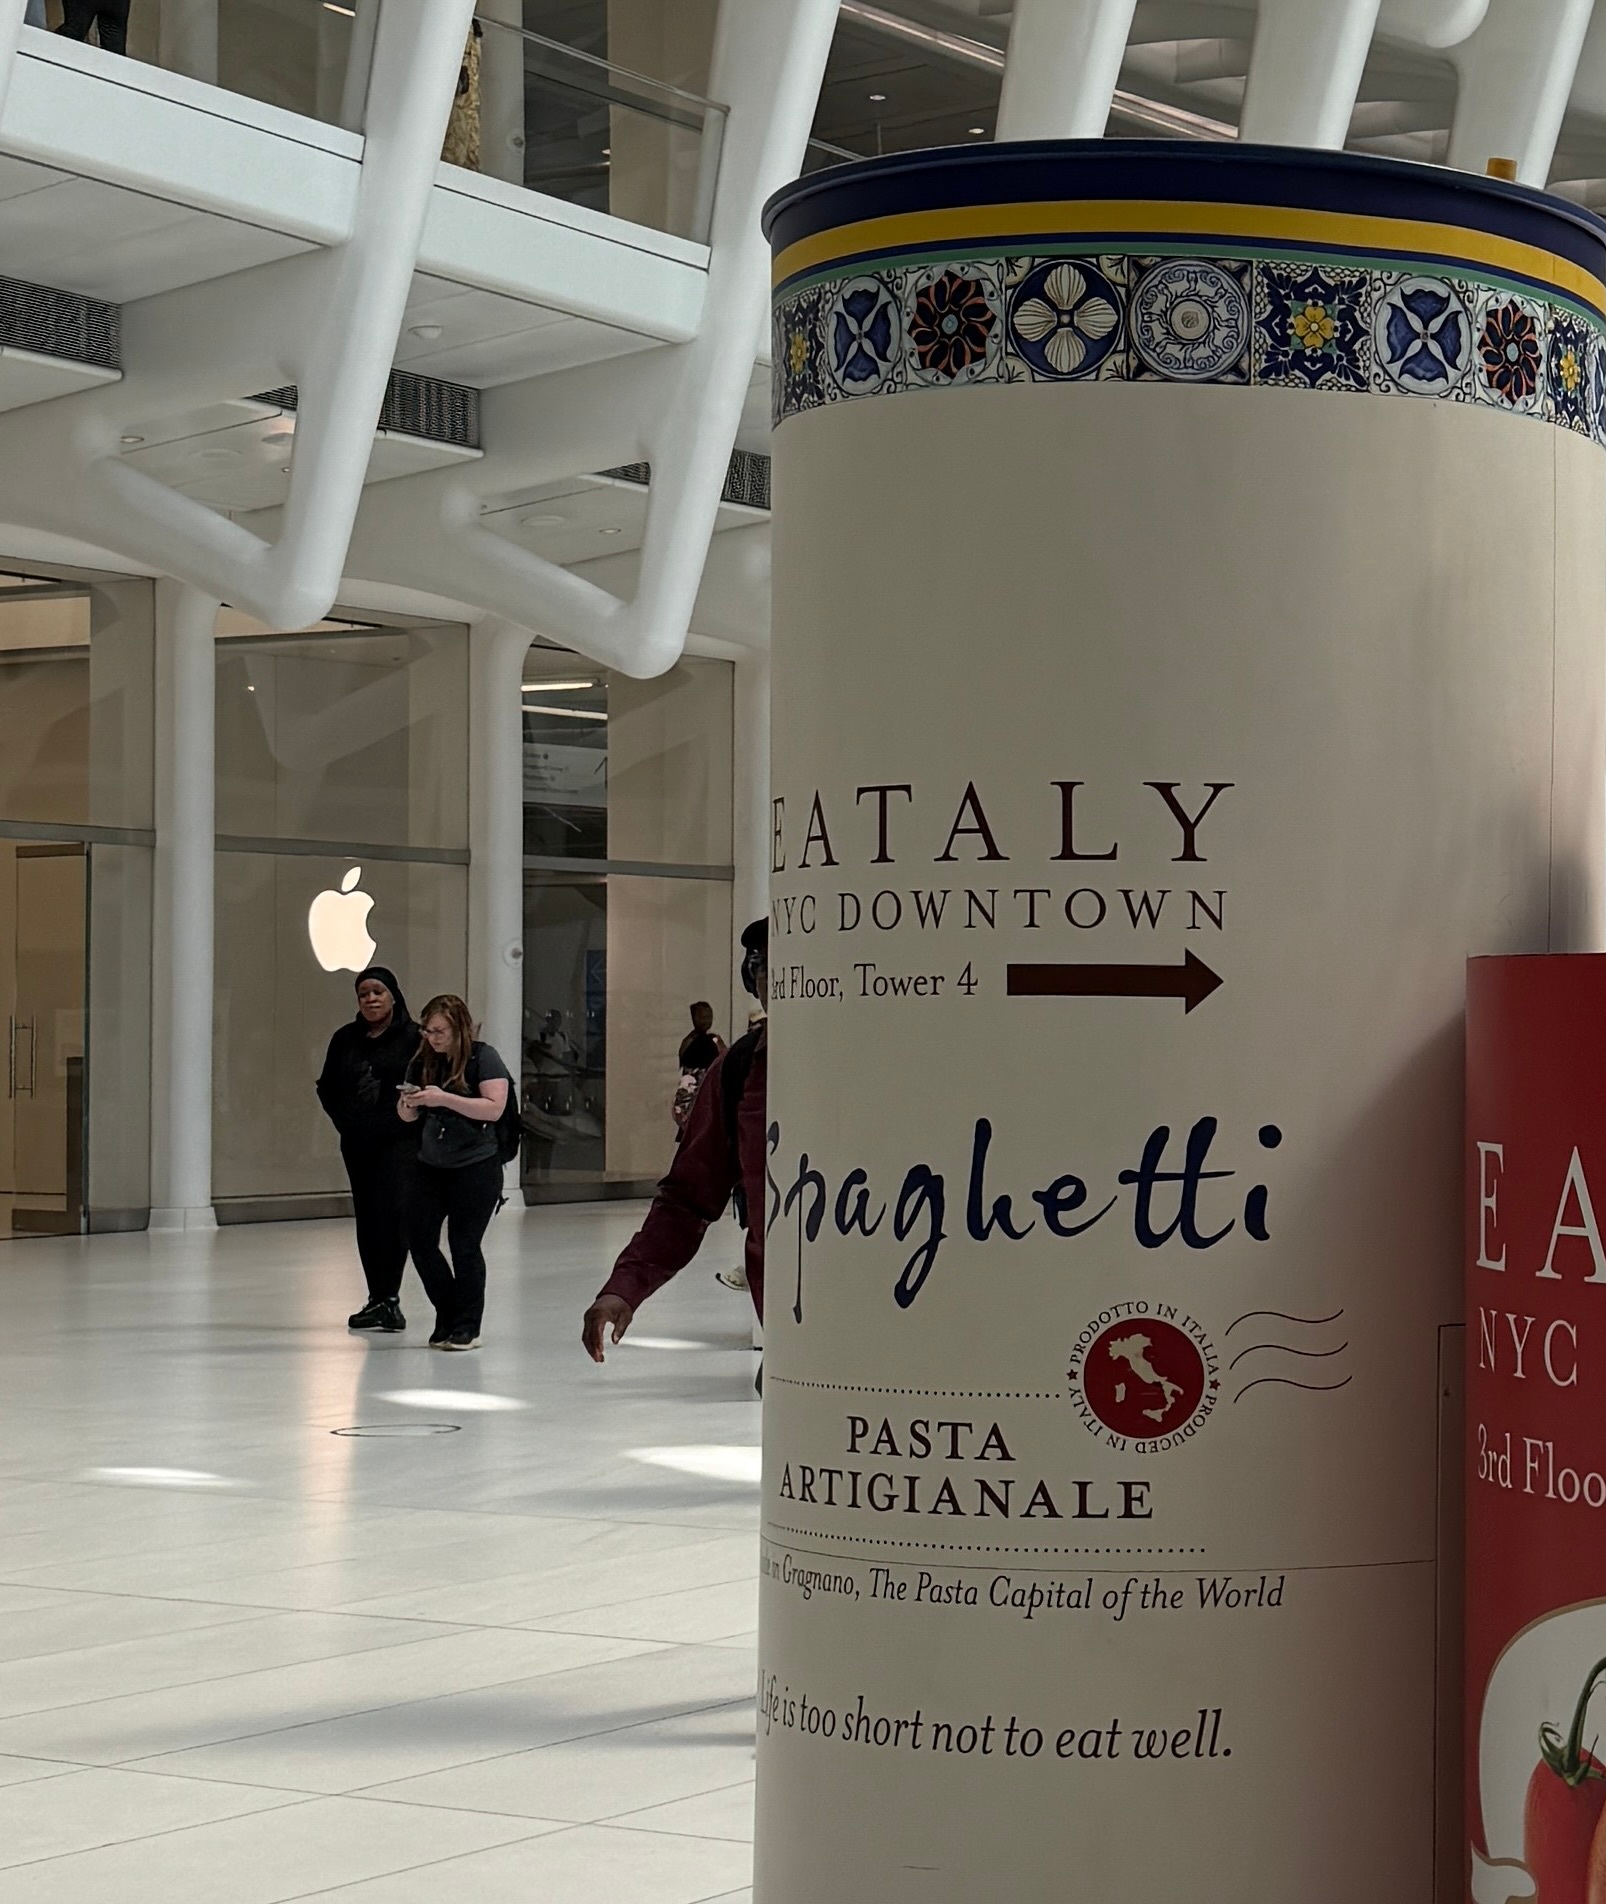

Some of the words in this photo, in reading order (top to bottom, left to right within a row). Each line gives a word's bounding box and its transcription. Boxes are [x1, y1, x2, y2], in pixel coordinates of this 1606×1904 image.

[771, 781, 1235, 873] EATALY
[771, 894, 816, 936] NYC
[838, 889, 1227, 931] DOWNTOWN
[790, 965, 843, 1002] Floor,
[854, 963, 944, 997] Tower
[956, 962, 978, 996] 4
[766, 1116, 1282, 1324] Spaghetti
[1070, 1301, 1148, 1364] PRODOTTO
[1157, 1303, 1178, 1319] IN
[1182, 1315, 1219, 1375] ITALIA
[1478, 1307, 1577, 1387] NYC
[847, 1415, 1016, 1461] PASTA
[1068, 1387, 1103, 1437] ITALY
[1106, 1434, 1127, 1451] IN
[1135, 1394, 1217, 1454] PRODUCED
[1478, 1423, 1512, 1488] 3rd
[780, 1462, 1152, 1519] ARTIGIANALE
[783, 1554, 859, 1601] Gragnano,
[870, 1568, 907, 1600] The
[914, 1572, 978, 1605] Pasta
[989, 1576, 1093, 1619] Capital
[1102, 1578, 1138, 1621] of
[1141, 1578, 1184, 1609] the
[1197, 1576, 1286, 1608] World
[783, 1686, 796, 1728] is
[801, 1694, 836, 1737] too
[842, 1696, 923, 1749] short
[932, 1716, 994, 1754] not
[1004, 1716, 1043, 1757] to
[1056, 1718, 1121, 1758] eat
[1132, 1709, 1232, 1758] well.
